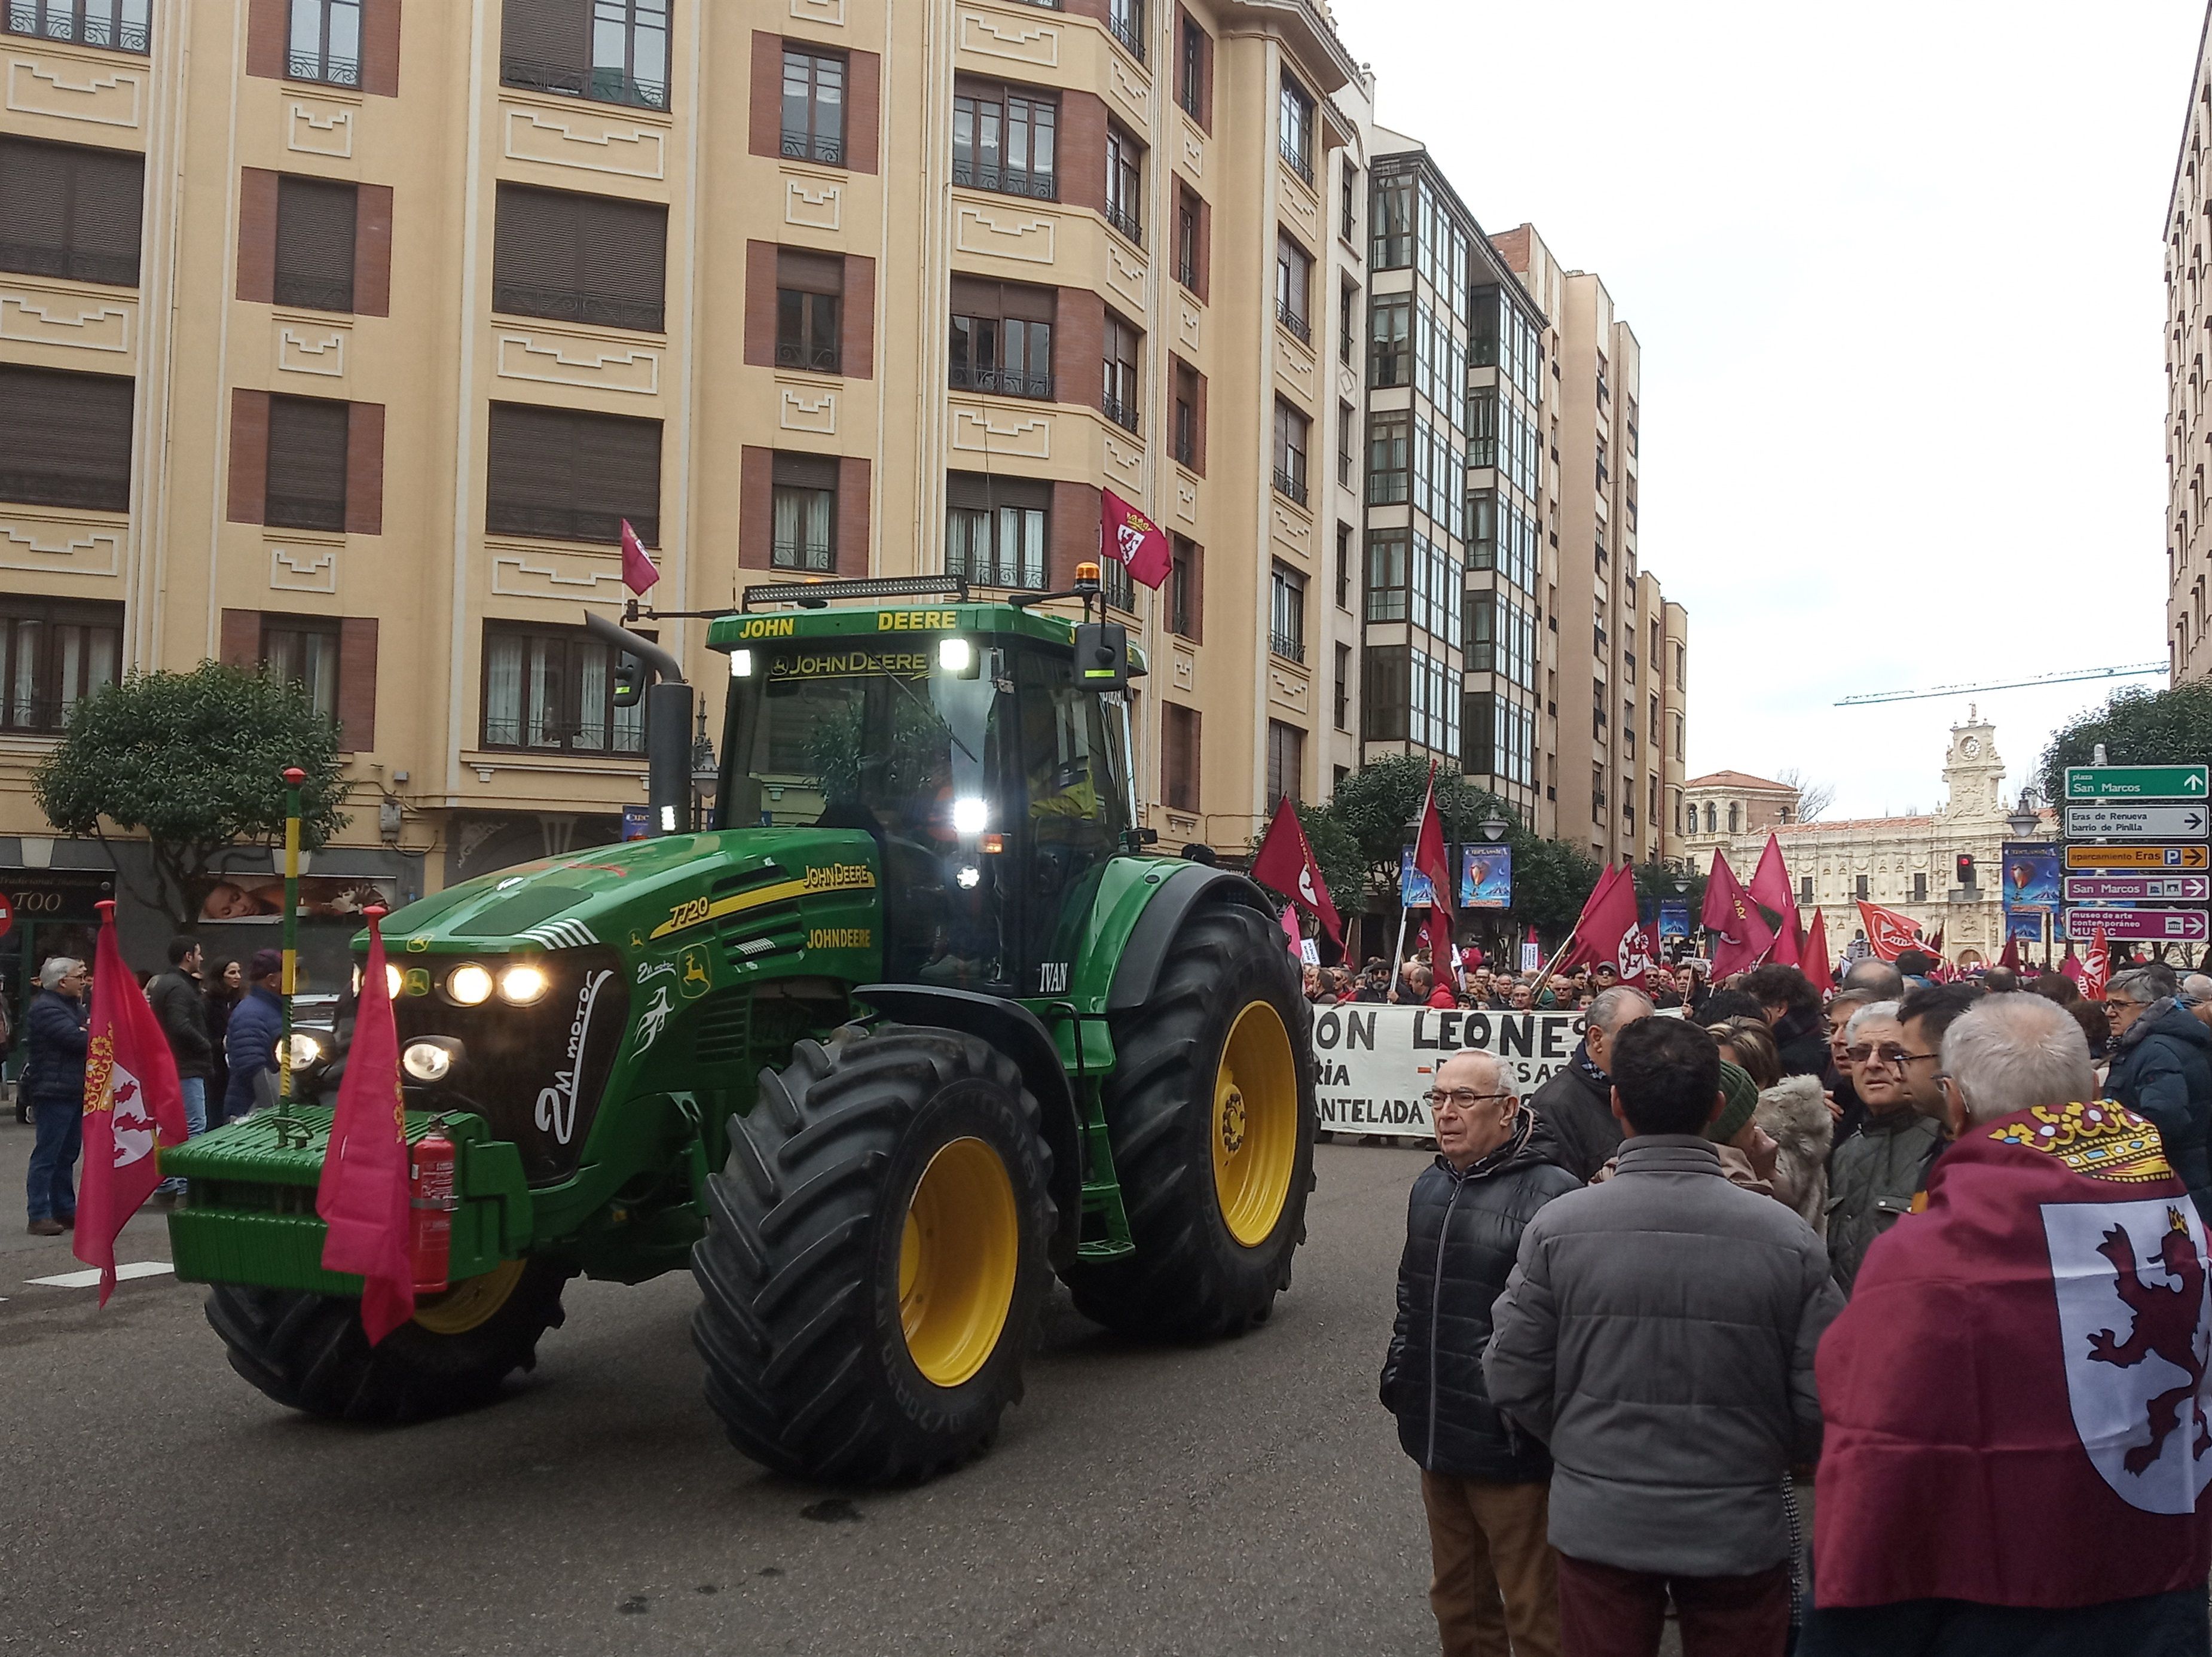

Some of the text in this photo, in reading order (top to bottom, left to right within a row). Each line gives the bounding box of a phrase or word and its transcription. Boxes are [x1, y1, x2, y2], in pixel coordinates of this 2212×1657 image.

[740, 611, 957, 639] JOHN DEERE
[2073, 783, 2141, 792] San Marcos
[2071, 853, 2132, 862] aparcamiento
[2135, 851, 2161, 860] Eras
[11, 890, 61, 911] TOO
[2073, 884, 2140, 893] San Marcos
[669, 897, 709, 927] 7720
[1039, 962, 1068, 993] IVAN
[1316, 1010, 1377, 1051] ON
[1316, 1098, 1425, 1124] NTELADA
